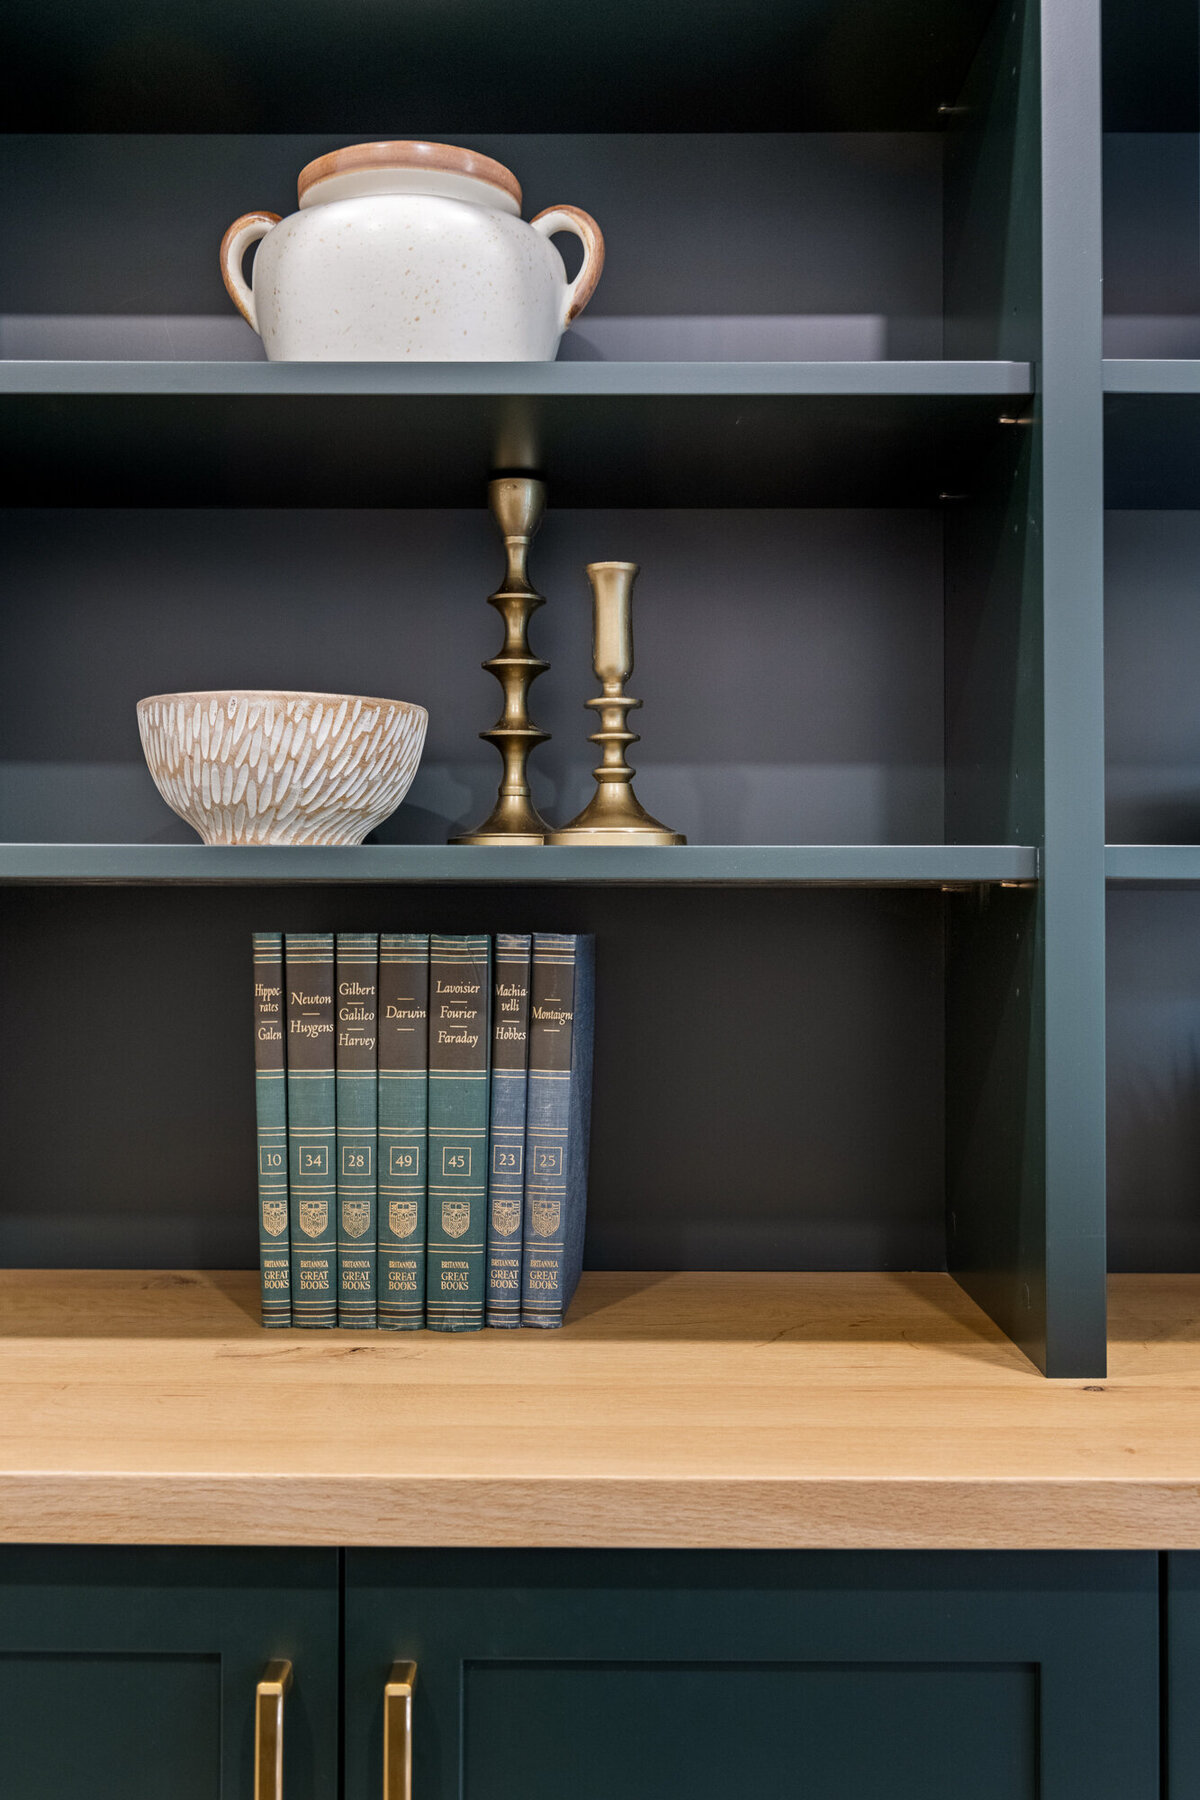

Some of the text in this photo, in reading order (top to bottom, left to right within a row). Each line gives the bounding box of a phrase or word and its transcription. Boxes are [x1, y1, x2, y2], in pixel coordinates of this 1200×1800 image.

[255, 984, 282, 1001] Hippoc-
[339, 983, 375, 995] Gilbert
[436, 981, 480, 994] Lavoisier
[291, 992, 332, 1005] Newton
[260, 1004, 279, 1012] rates
[501, 999, 520, 1012] velli
[339, 1008, 375, 1021] Galileo
[386, 1006, 426, 1019] Darwin
[440, 1006, 477, 1019] Fourier
[258, 1028, 282, 1040] Galen
[290, 1020, 334, 1038] Huygens
[496, 1027, 526, 1040] Hobbes
[339, 1034, 375, 1050] Harvey
[438, 1031, 478, 1048] Faraday
[266, 1154, 282, 1167] 10
[305, 1154, 322, 1167] 34
[348, 1155, 364, 1167] 28
[395, 1155, 412, 1167] 49
[448, 1156, 465, 1168] 45
[499, 1154, 516, 1166] 23
[540, 1155, 556, 1167] 25
[264, 1270, 289, 1280] GREAT
[300, 1271, 328, 1280] GREAT
[343, 1271, 370, 1280] GREAT
[389, 1272, 417, 1281] GREAT
[441, 1272, 469, 1281] GREAT
[491, 1270, 519, 1279] GREAT
[530, 1271, 558, 1280] GREAT
[264, 1280, 289, 1288] BOOKS
[300, 1281, 328, 1290] BOOKS
[343, 1281, 370, 1290] BOOKS
[389, 1281, 417, 1290] BOOKS
[441, 1281, 469, 1290] BOOKS
[491, 1280, 519, 1288] BOOKS
[530, 1280, 558, 1289] BOOKS
